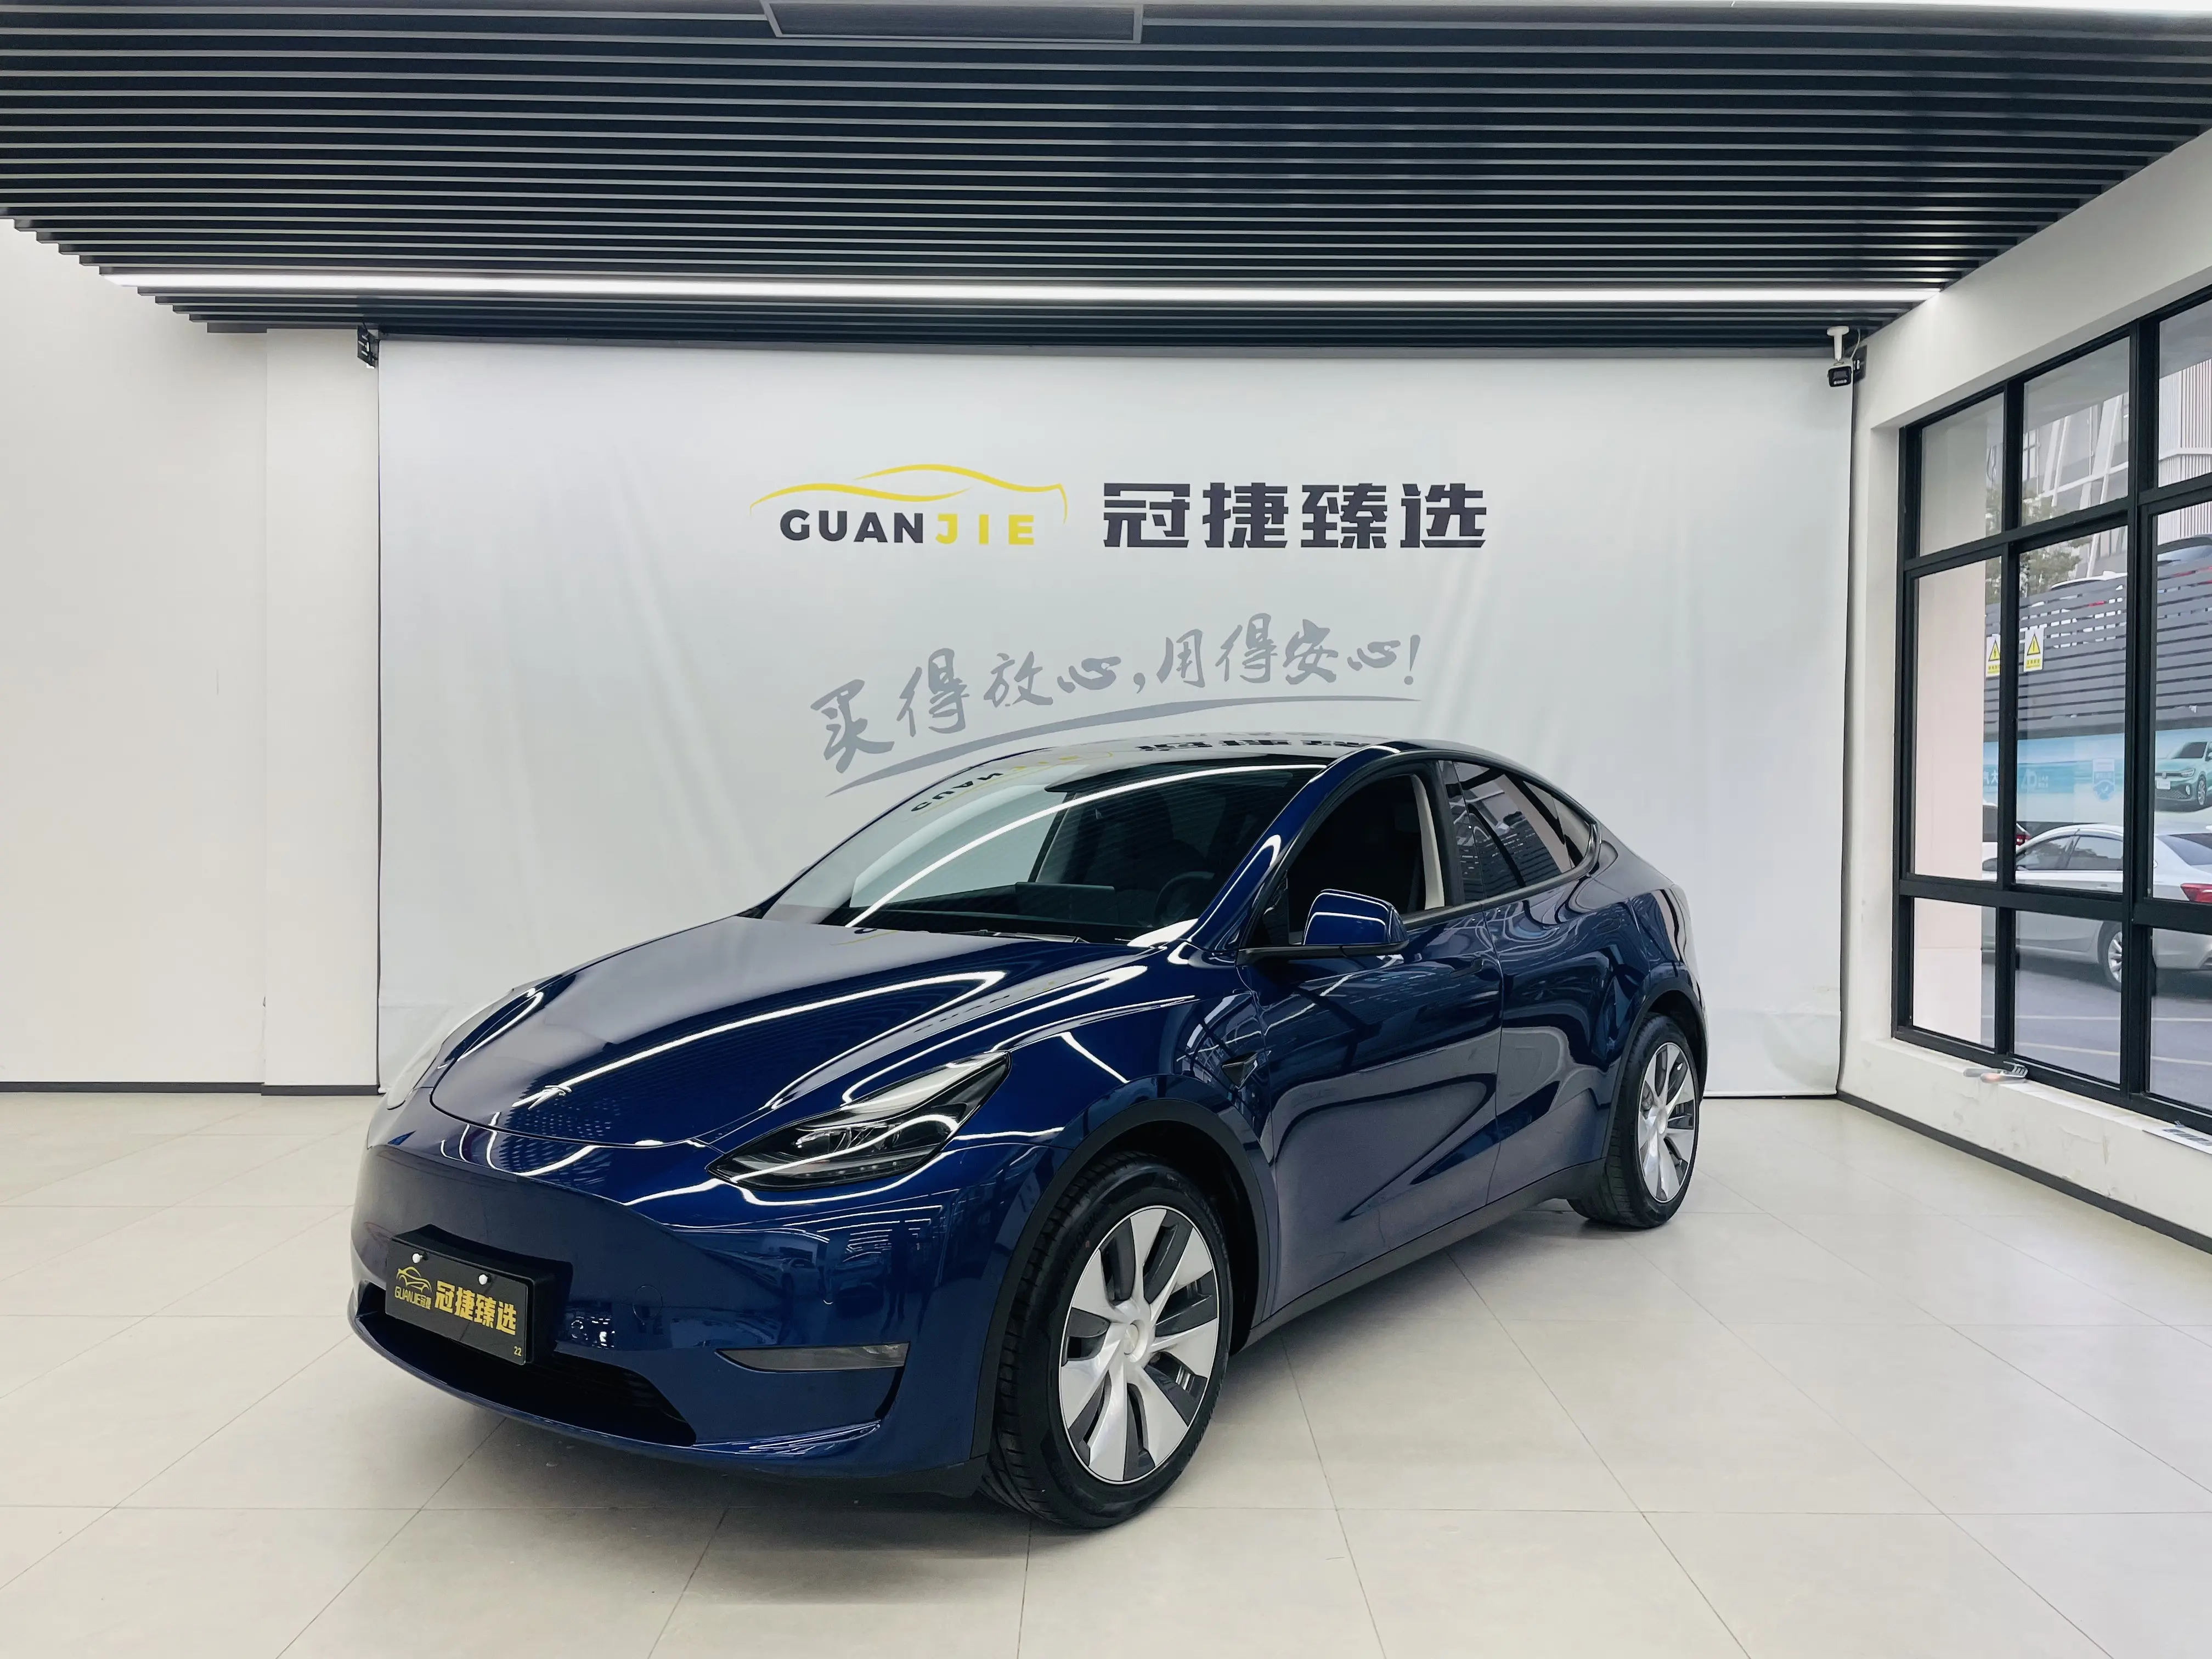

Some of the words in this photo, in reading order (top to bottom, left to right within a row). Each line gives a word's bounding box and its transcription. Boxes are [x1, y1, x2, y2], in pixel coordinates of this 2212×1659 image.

[780, 510, 1034, 545] GUANJIE
[1103, 482, 1487, 549] 冠捷臻选
[435, 1280, 517, 1335] 冠捷臻选
[514, 1346, 522, 1357] 22
